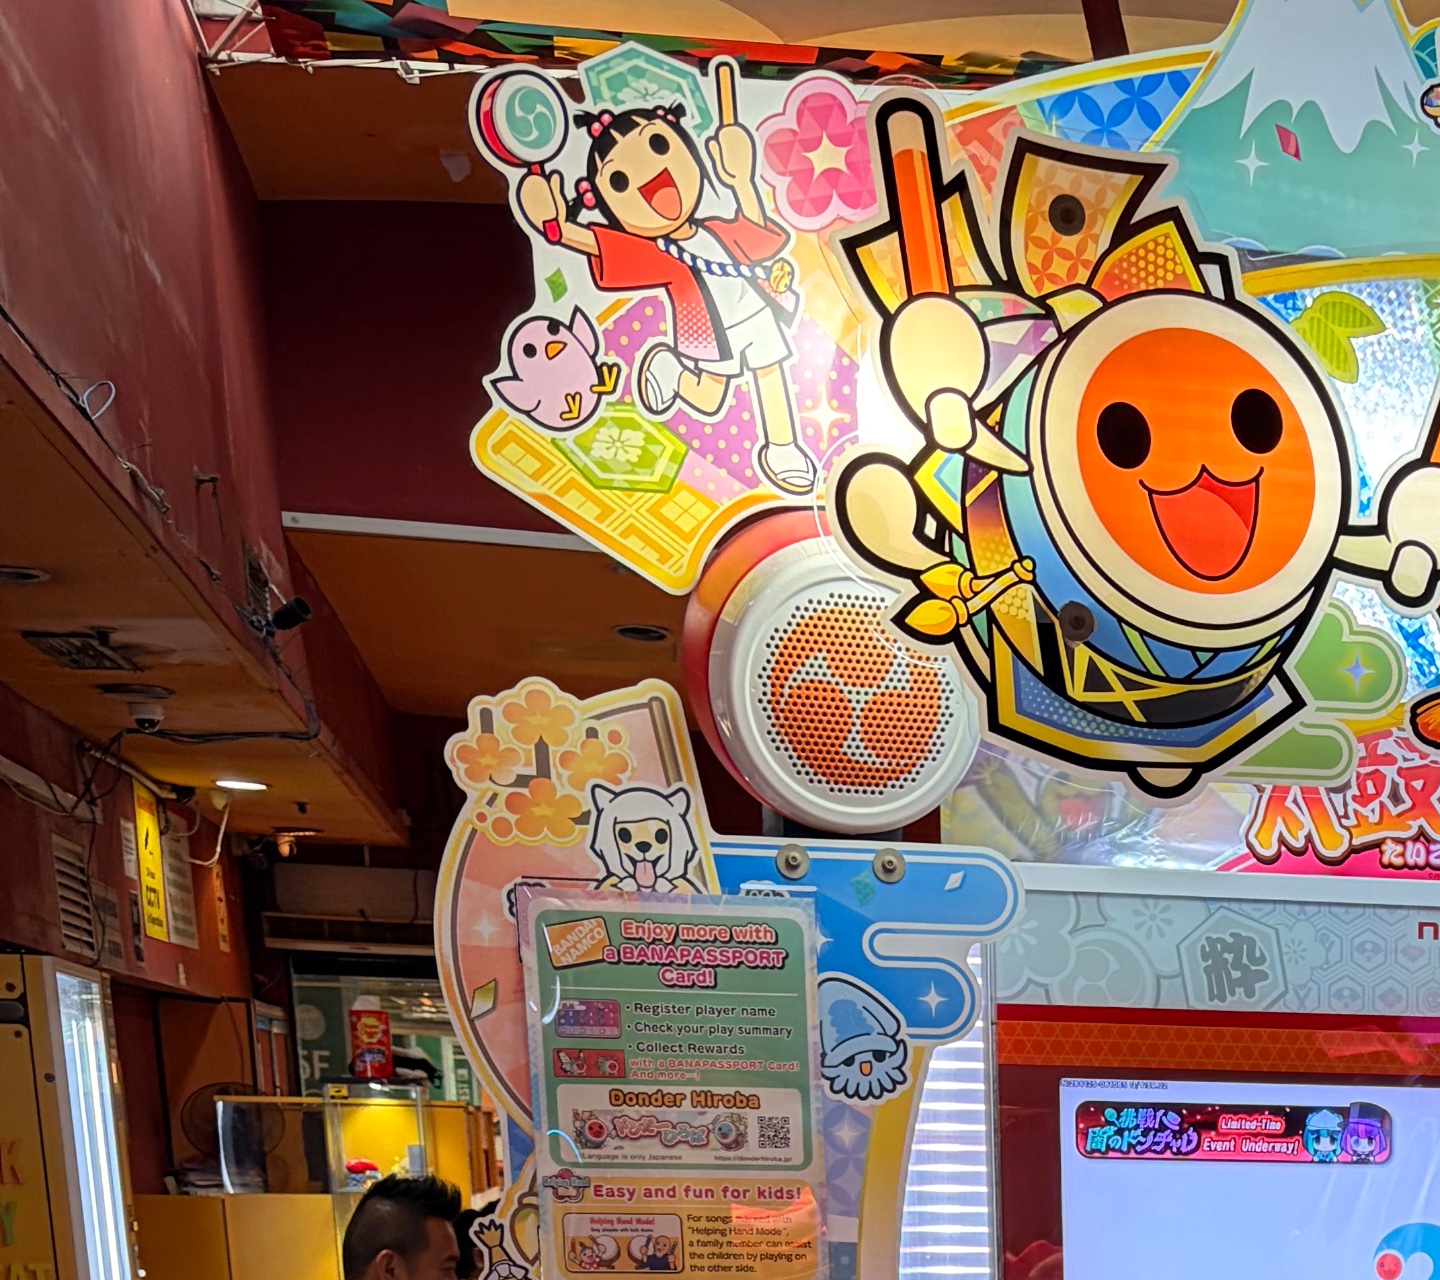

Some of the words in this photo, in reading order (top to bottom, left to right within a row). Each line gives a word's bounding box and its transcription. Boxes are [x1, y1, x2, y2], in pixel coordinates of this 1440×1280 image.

[551, 920, 596, 958] BANDAI
[621, 919, 674, 943] Enjoy
[679, 924, 728, 940] more
[733, 923, 775, 942] with
[560, 927, 604, 965] NAMCO
[603, 949, 616, 961] a
[623, 946, 785, 966] BANAPASSPORT
[659, 968, 715, 986] Card!
[634, 1003, 691, 1016] Register
[696, 1004, 738, 1018] player
[742, 1006, 776, 1017] name
[635, 1022, 672, 1033] Check
[677, 1025, 704, 1036] your
[709, 1024, 734, 1037] play
[738, 1026, 792, 1039] summary
[637, 1042, 683, 1053] Collect
[688, 1043, 745, 1055] Rewards
[609, 1089, 686, 1107] Donder
[691, 1091, 760, 1109] Hiroba
[1221, 1118, 1282, 1131] Limited-Time
[1203, 1138, 1235, 1151] Event
[1241, 1139, 1299, 1155] Underway!
[593, 1184, 635, 1202] Easy
[644, 1185, 676, 1199] and
[684, 1186, 714, 1200] fun
[721, 1186, 748, 1200] for
[757, 1186, 801, 1200] kids!
